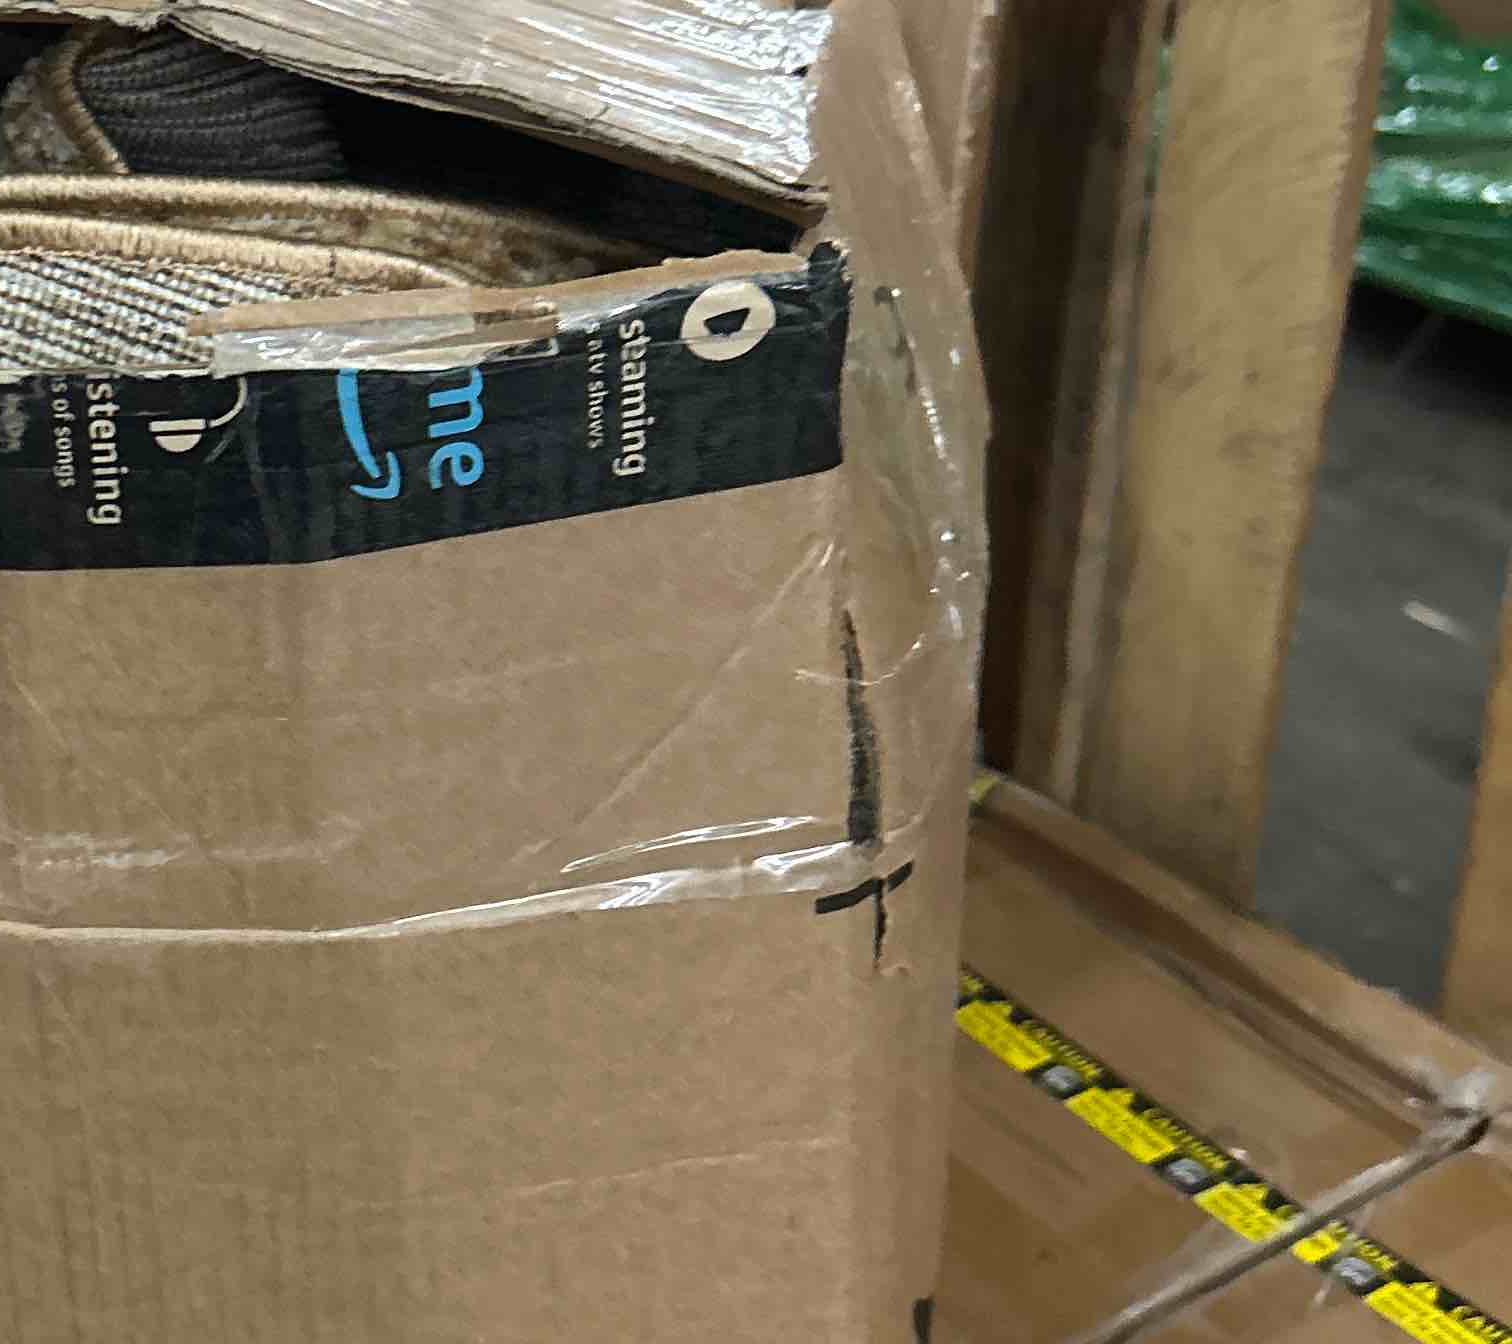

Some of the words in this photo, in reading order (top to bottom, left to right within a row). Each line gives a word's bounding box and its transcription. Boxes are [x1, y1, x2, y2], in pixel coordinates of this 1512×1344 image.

[51, 398, 75, 422] of
[586, 379, 608, 448] shows
[52, 425, 76, 487] songs
